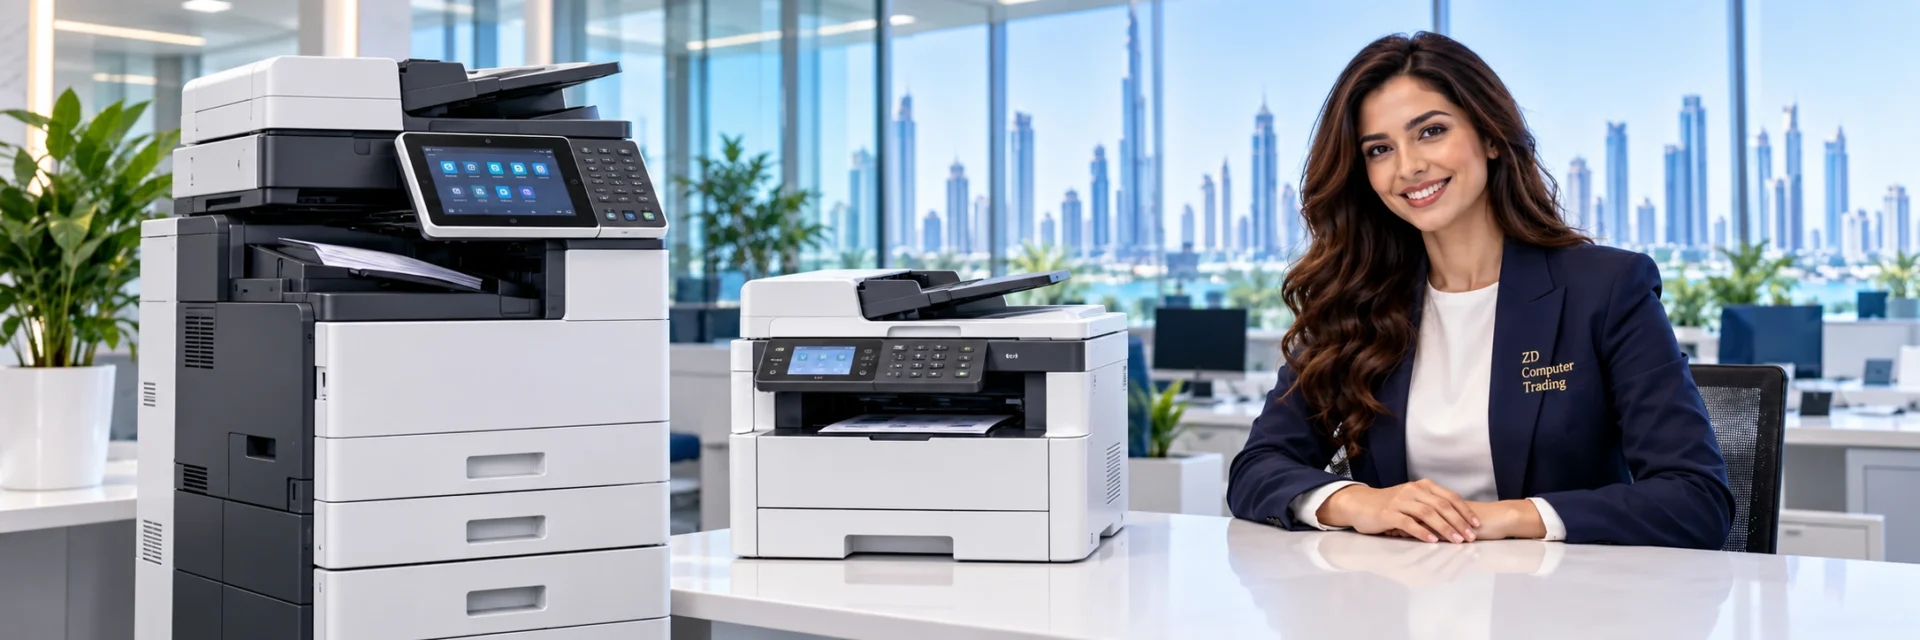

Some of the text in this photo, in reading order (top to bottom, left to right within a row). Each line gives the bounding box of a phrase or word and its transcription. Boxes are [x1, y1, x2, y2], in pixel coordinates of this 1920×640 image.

[1521, 350, 1540, 364] ZD
[1521, 362, 1575, 378] Computer
[1522, 379, 1567, 393] Trading
